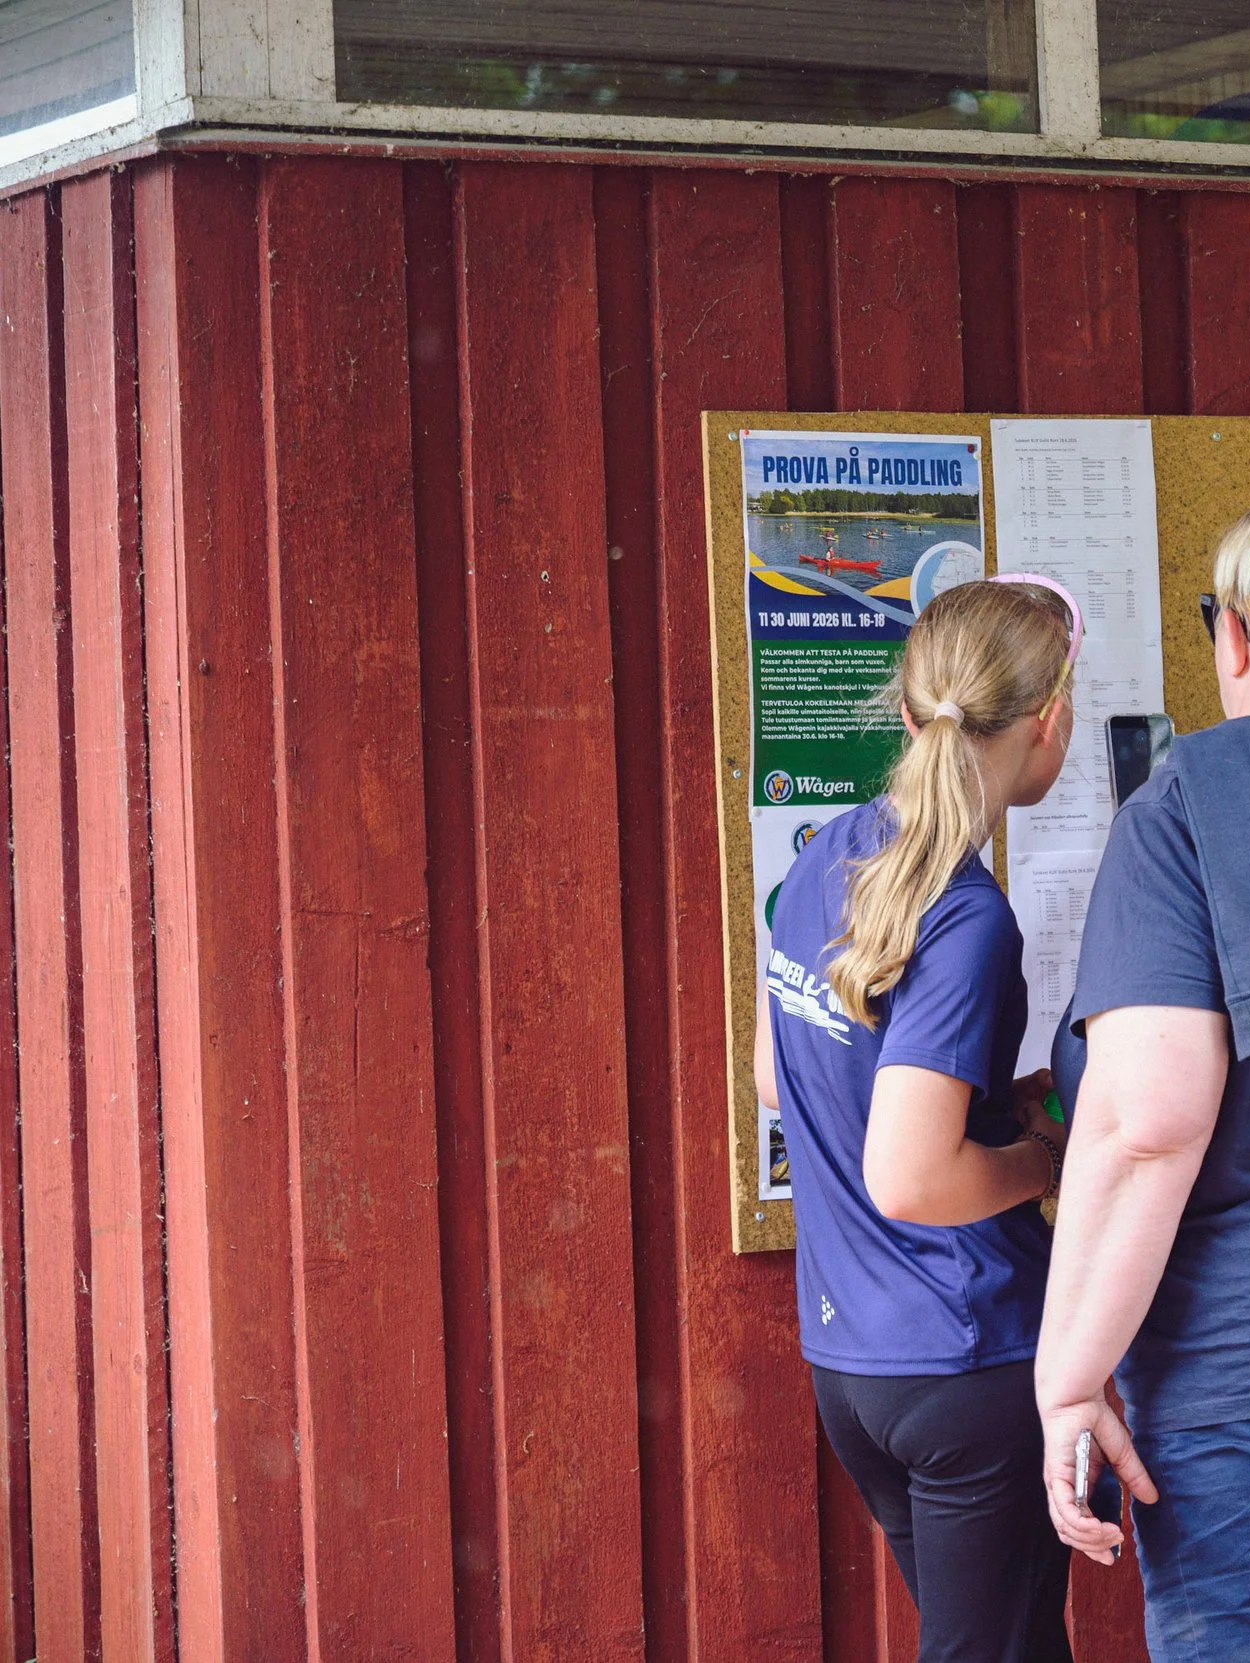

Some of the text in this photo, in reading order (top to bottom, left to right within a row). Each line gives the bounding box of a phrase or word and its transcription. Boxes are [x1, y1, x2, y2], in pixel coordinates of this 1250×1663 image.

[762, 446, 963, 487] PROVA PÅ PADDLING
[758, 612, 886, 629] TI 30 JUNI 2026 KL. 16-18
[760, 648, 804, 657] VÄLKOMMEN
[842, 648, 853, 656] PÅ
[794, 658, 834, 666] simkunniga,
[816, 667, 827, 675] dig
[796, 683, 823, 691] Wågens
[788, 724, 816, 732] Wågenin
[795, 776, 856, 797] Wågen
